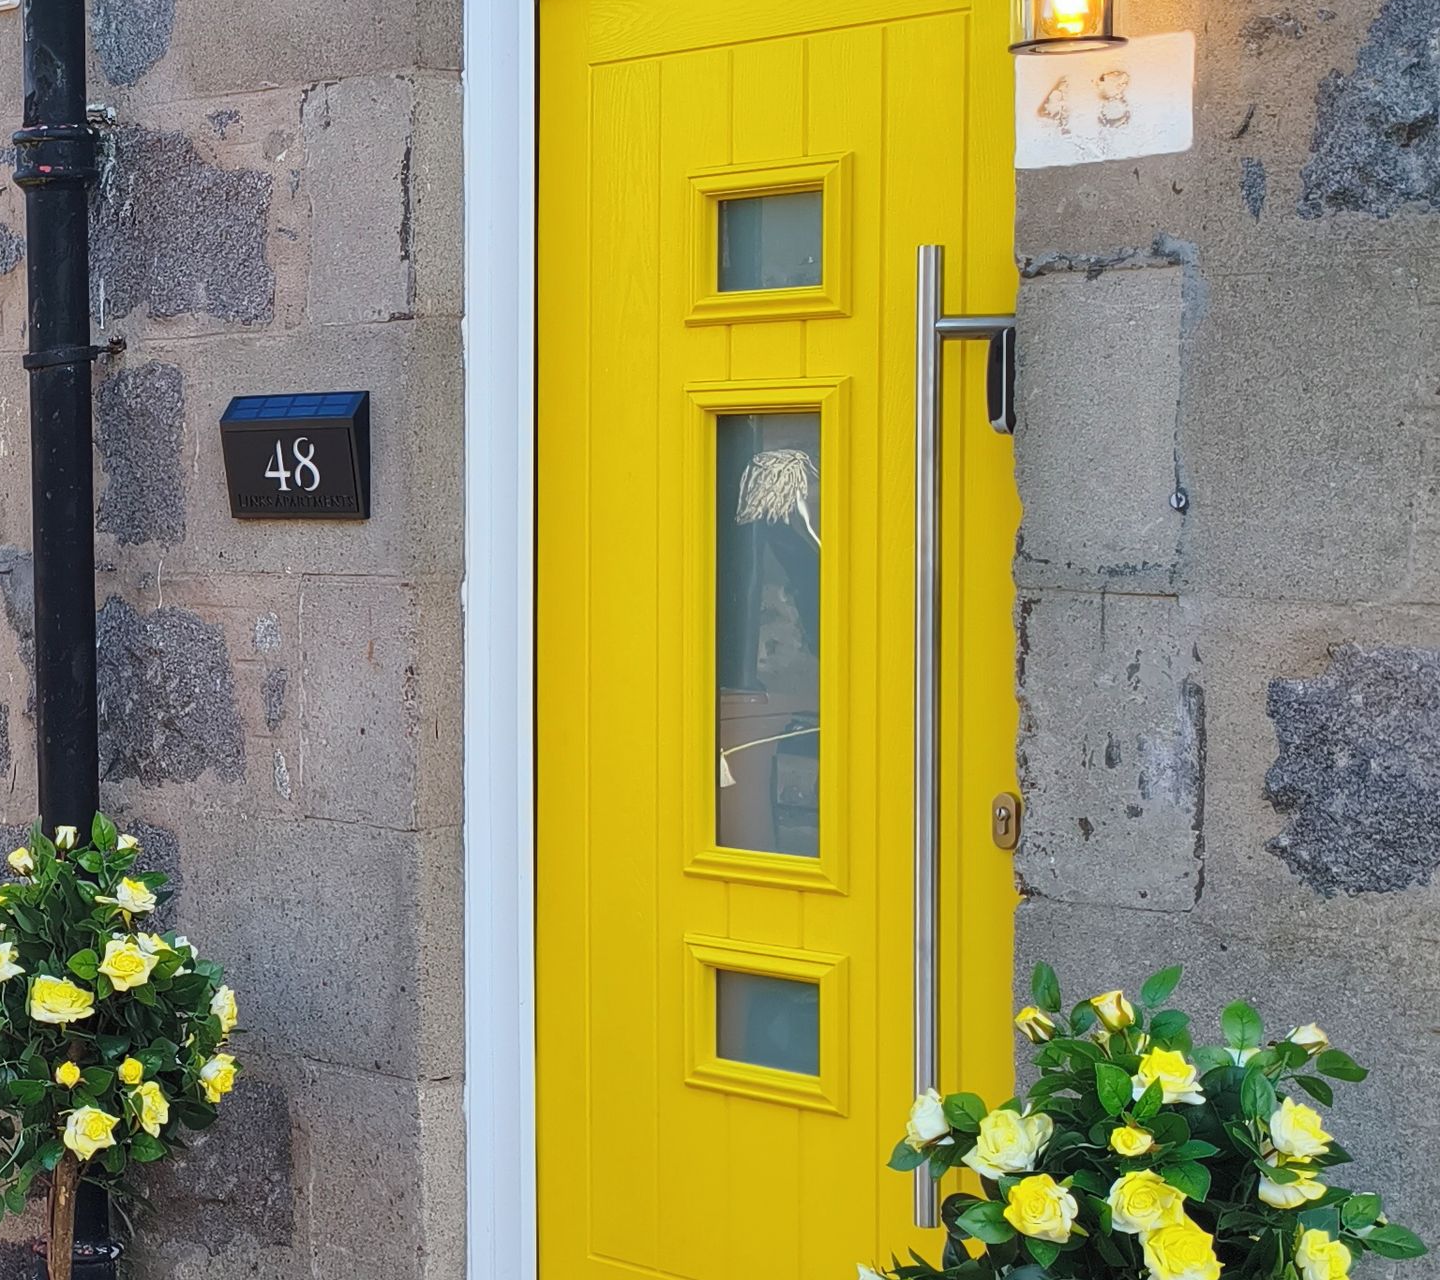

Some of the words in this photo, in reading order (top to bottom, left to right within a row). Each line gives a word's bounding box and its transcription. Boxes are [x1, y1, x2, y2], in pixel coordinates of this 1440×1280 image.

[1036, 70, 1131, 135] 48
[264, 437, 321, 492] 48
[239, 494, 273, 508] LINKS
[275, 493, 354, 508] APARTMENTS
